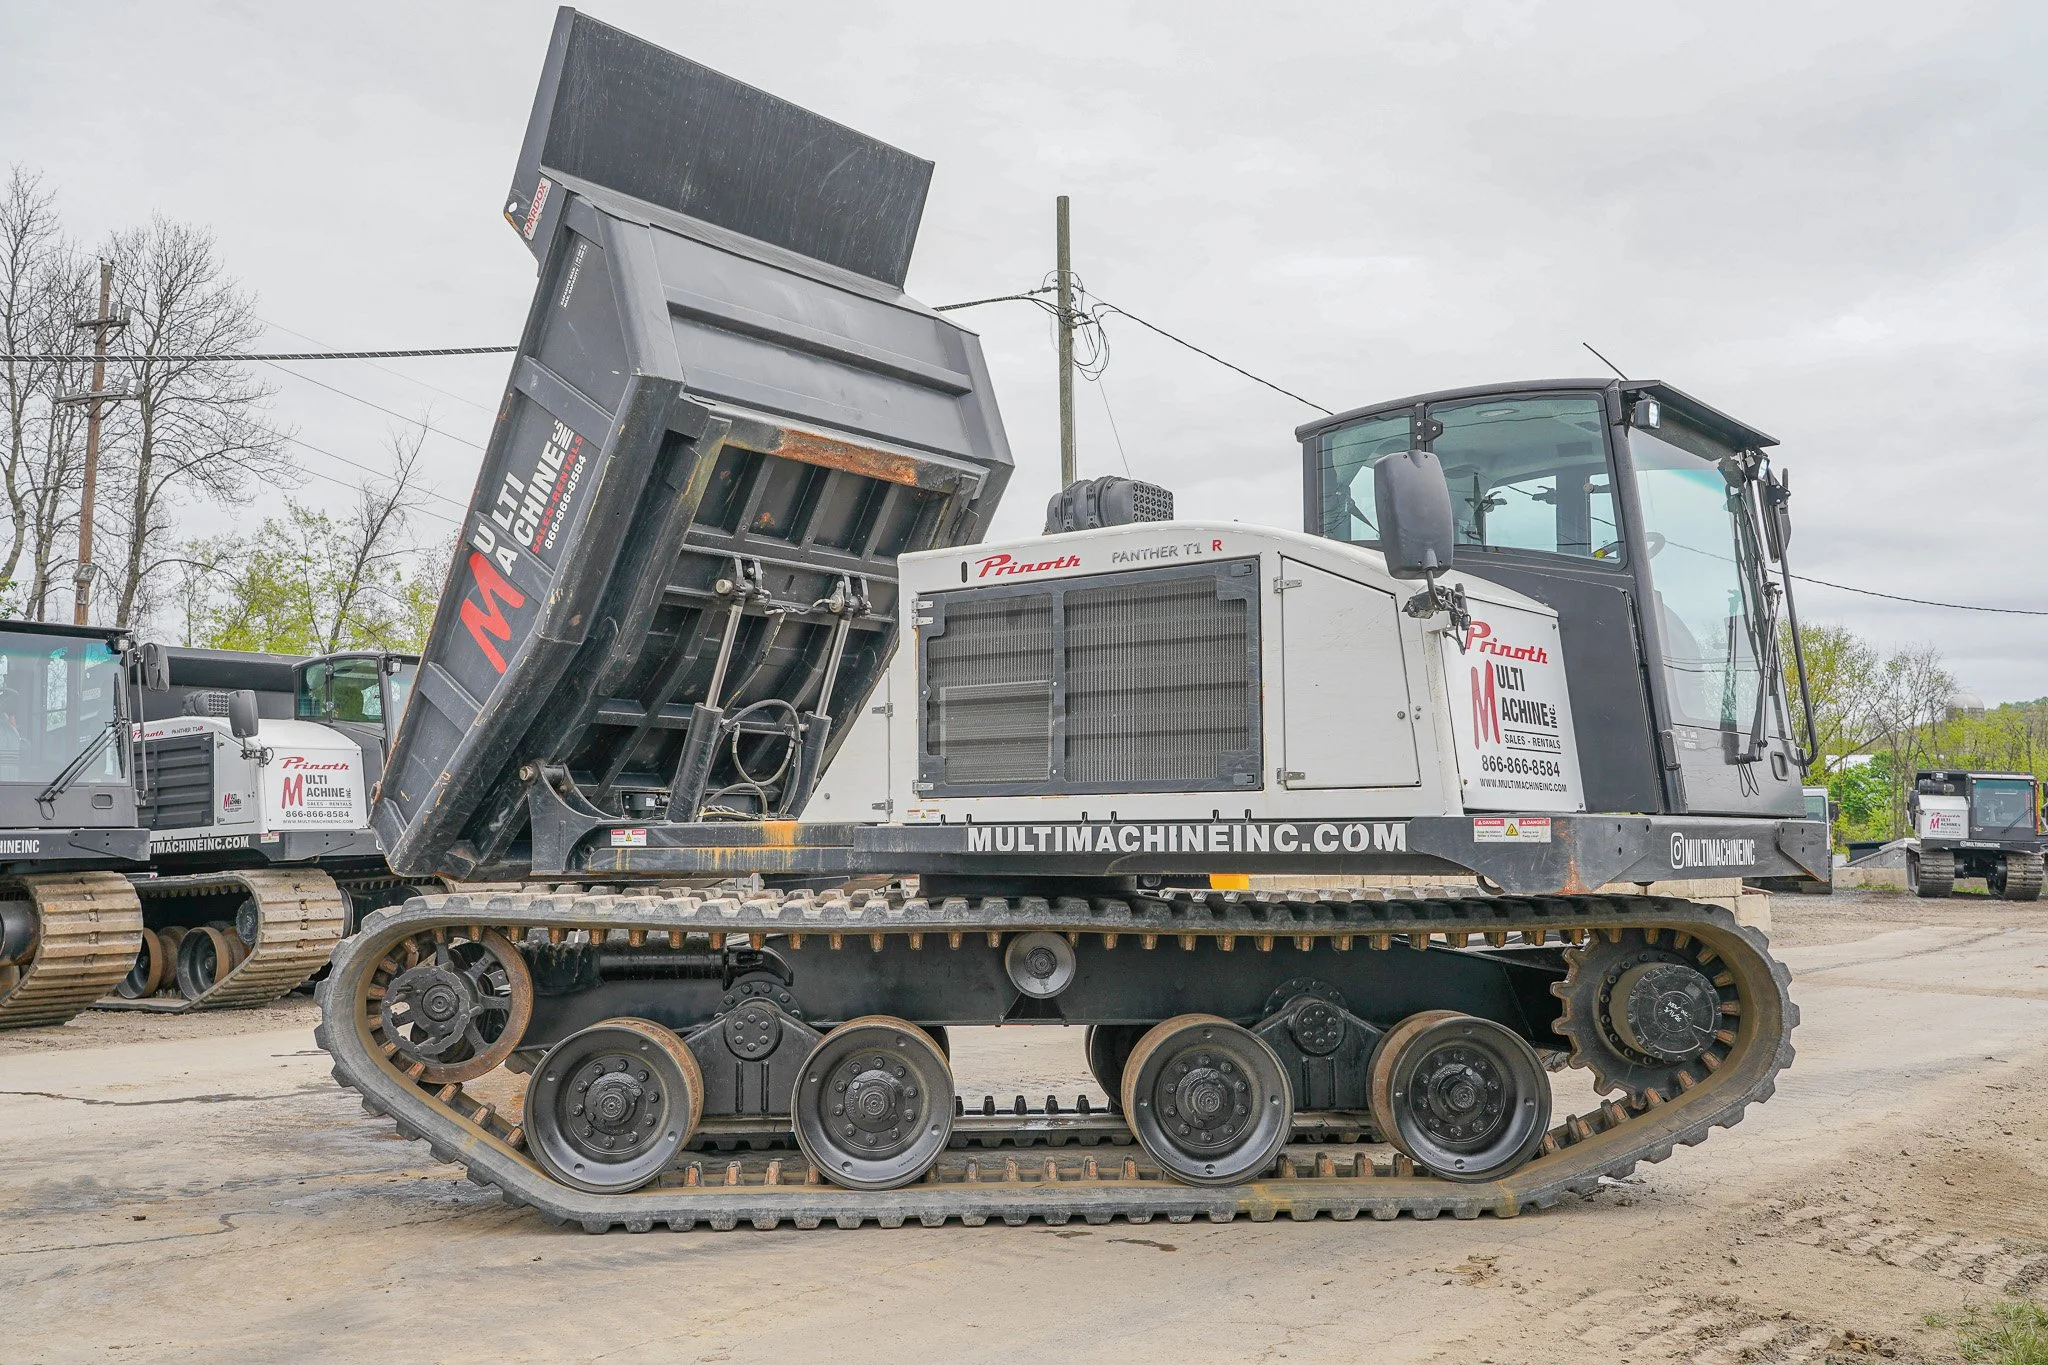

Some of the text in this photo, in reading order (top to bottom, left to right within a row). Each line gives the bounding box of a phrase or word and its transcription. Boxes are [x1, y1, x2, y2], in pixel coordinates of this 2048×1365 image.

[524, 182, 547, 236] HARDOX
[544, 455, 587, 550] 866-866-8584
[975, 554, 1081, 578] Prinoth
[1111, 546, 1178, 564] PANTHER
[1212, 539, 1223, 552] R
[1466, 620, 1548, 664] Prinoth
[1504, 733, 1526, 746] SALES
[1532, 737, 1561, 749] RENTALS
[279, 756, 350, 770] Prinoth
[1481, 754, 1561, 777] 866-866-8584
[1479, 778, 1568, 793] WWW.MULTIMACHINEINC.COM
[967, 823, 1407, 853] MULTIMACHINEINC.COM
[1684, 838, 1756, 868] MULTIMACHINEINC
